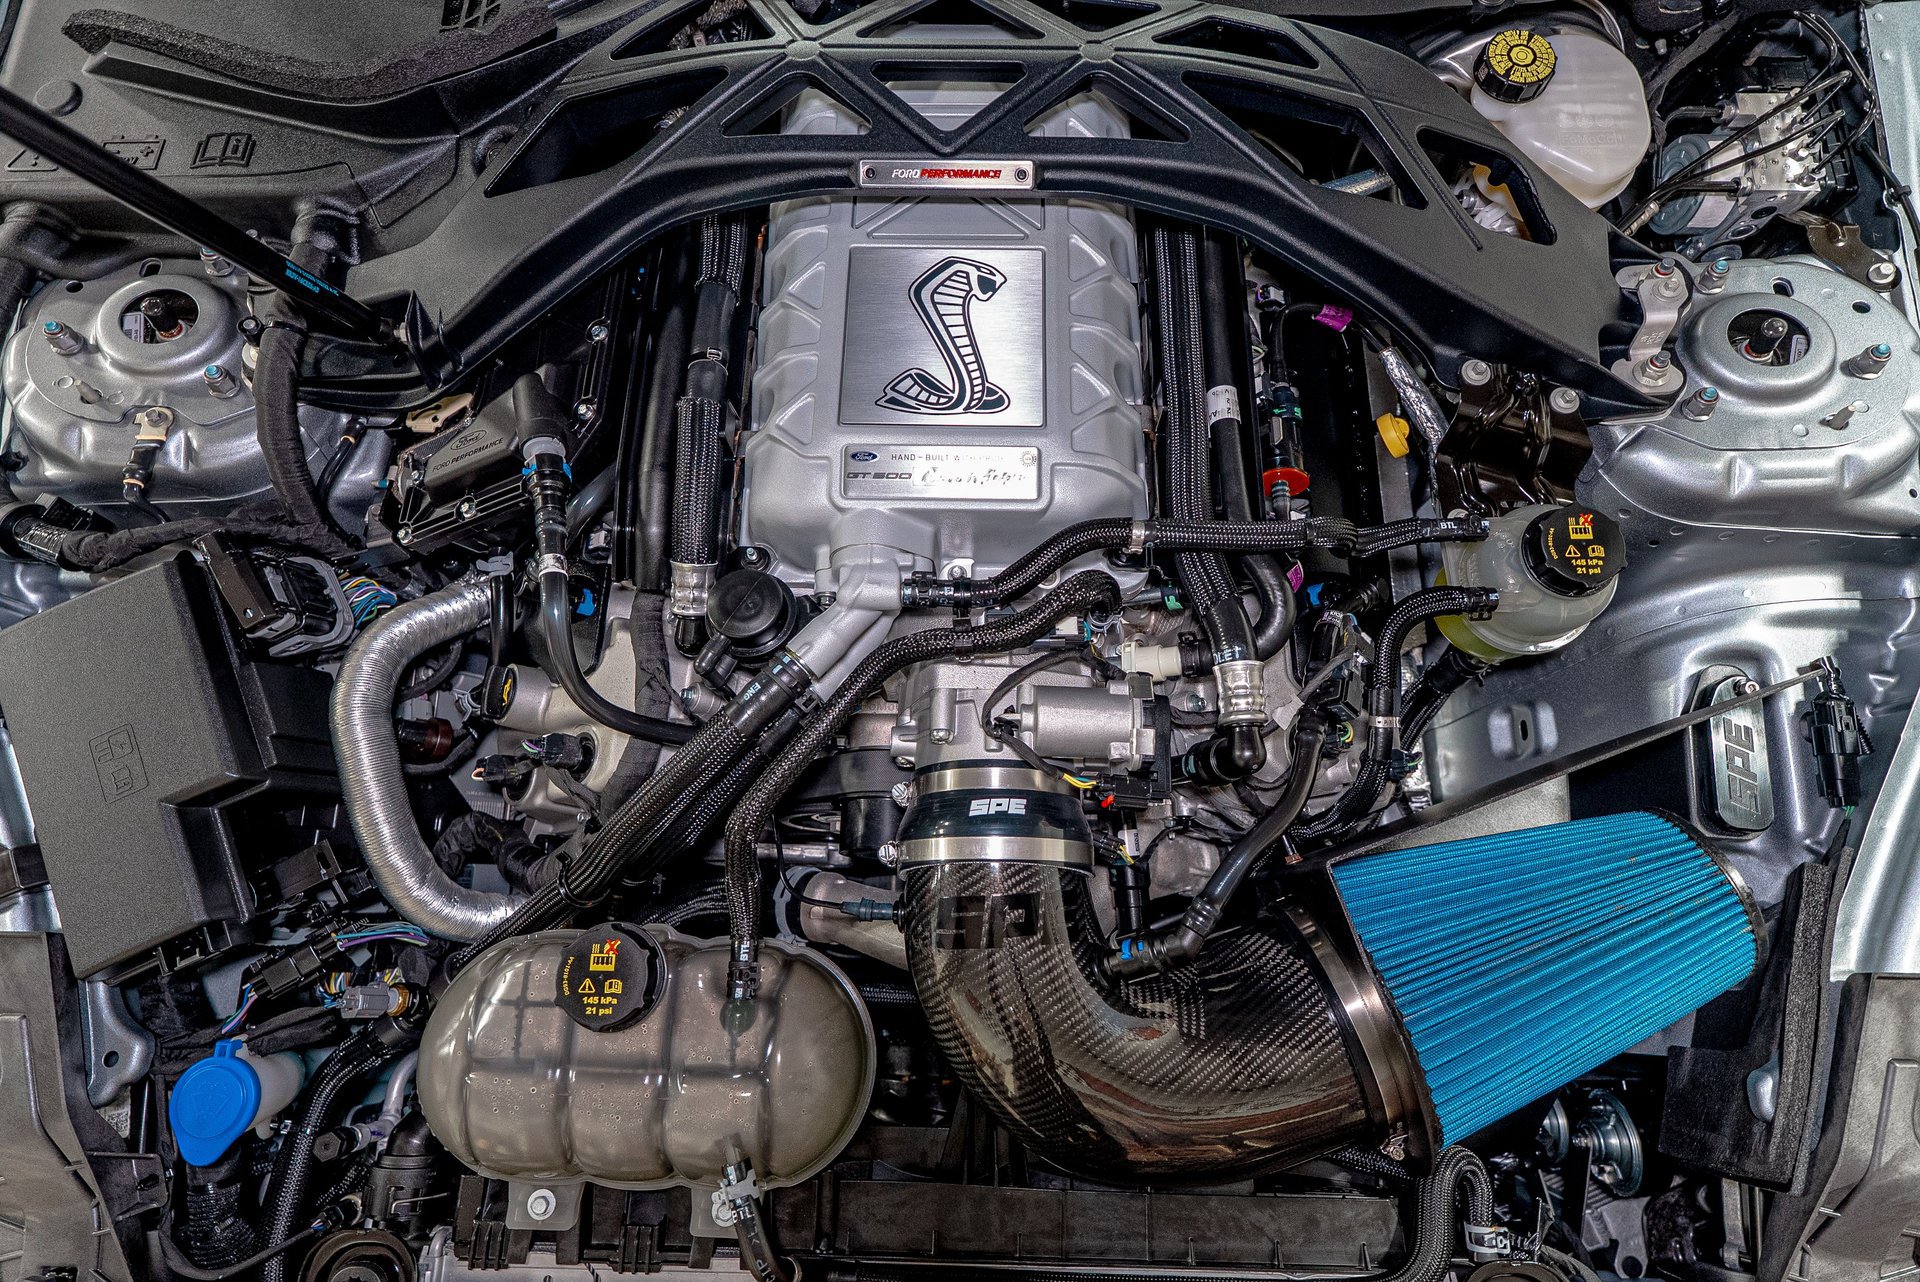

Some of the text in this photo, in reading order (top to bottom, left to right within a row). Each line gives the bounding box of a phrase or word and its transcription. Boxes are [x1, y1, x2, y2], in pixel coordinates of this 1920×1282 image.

[891, 168, 1002, 179] FORD PERFORMANCE
[432, 437, 504, 472] FORD PERFORMANCE
[891, 453, 916, 461] HAND
[1440, 521, 1457, 529] BTL
[1588, 567, 1601, 575] psi
[1723, 717, 1760, 814] SPE
[969, 798, 1027, 817] SPE
[582, 996, 618, 1004] 145 kPa
[585, 1007, 613, 1016] 21 psi
